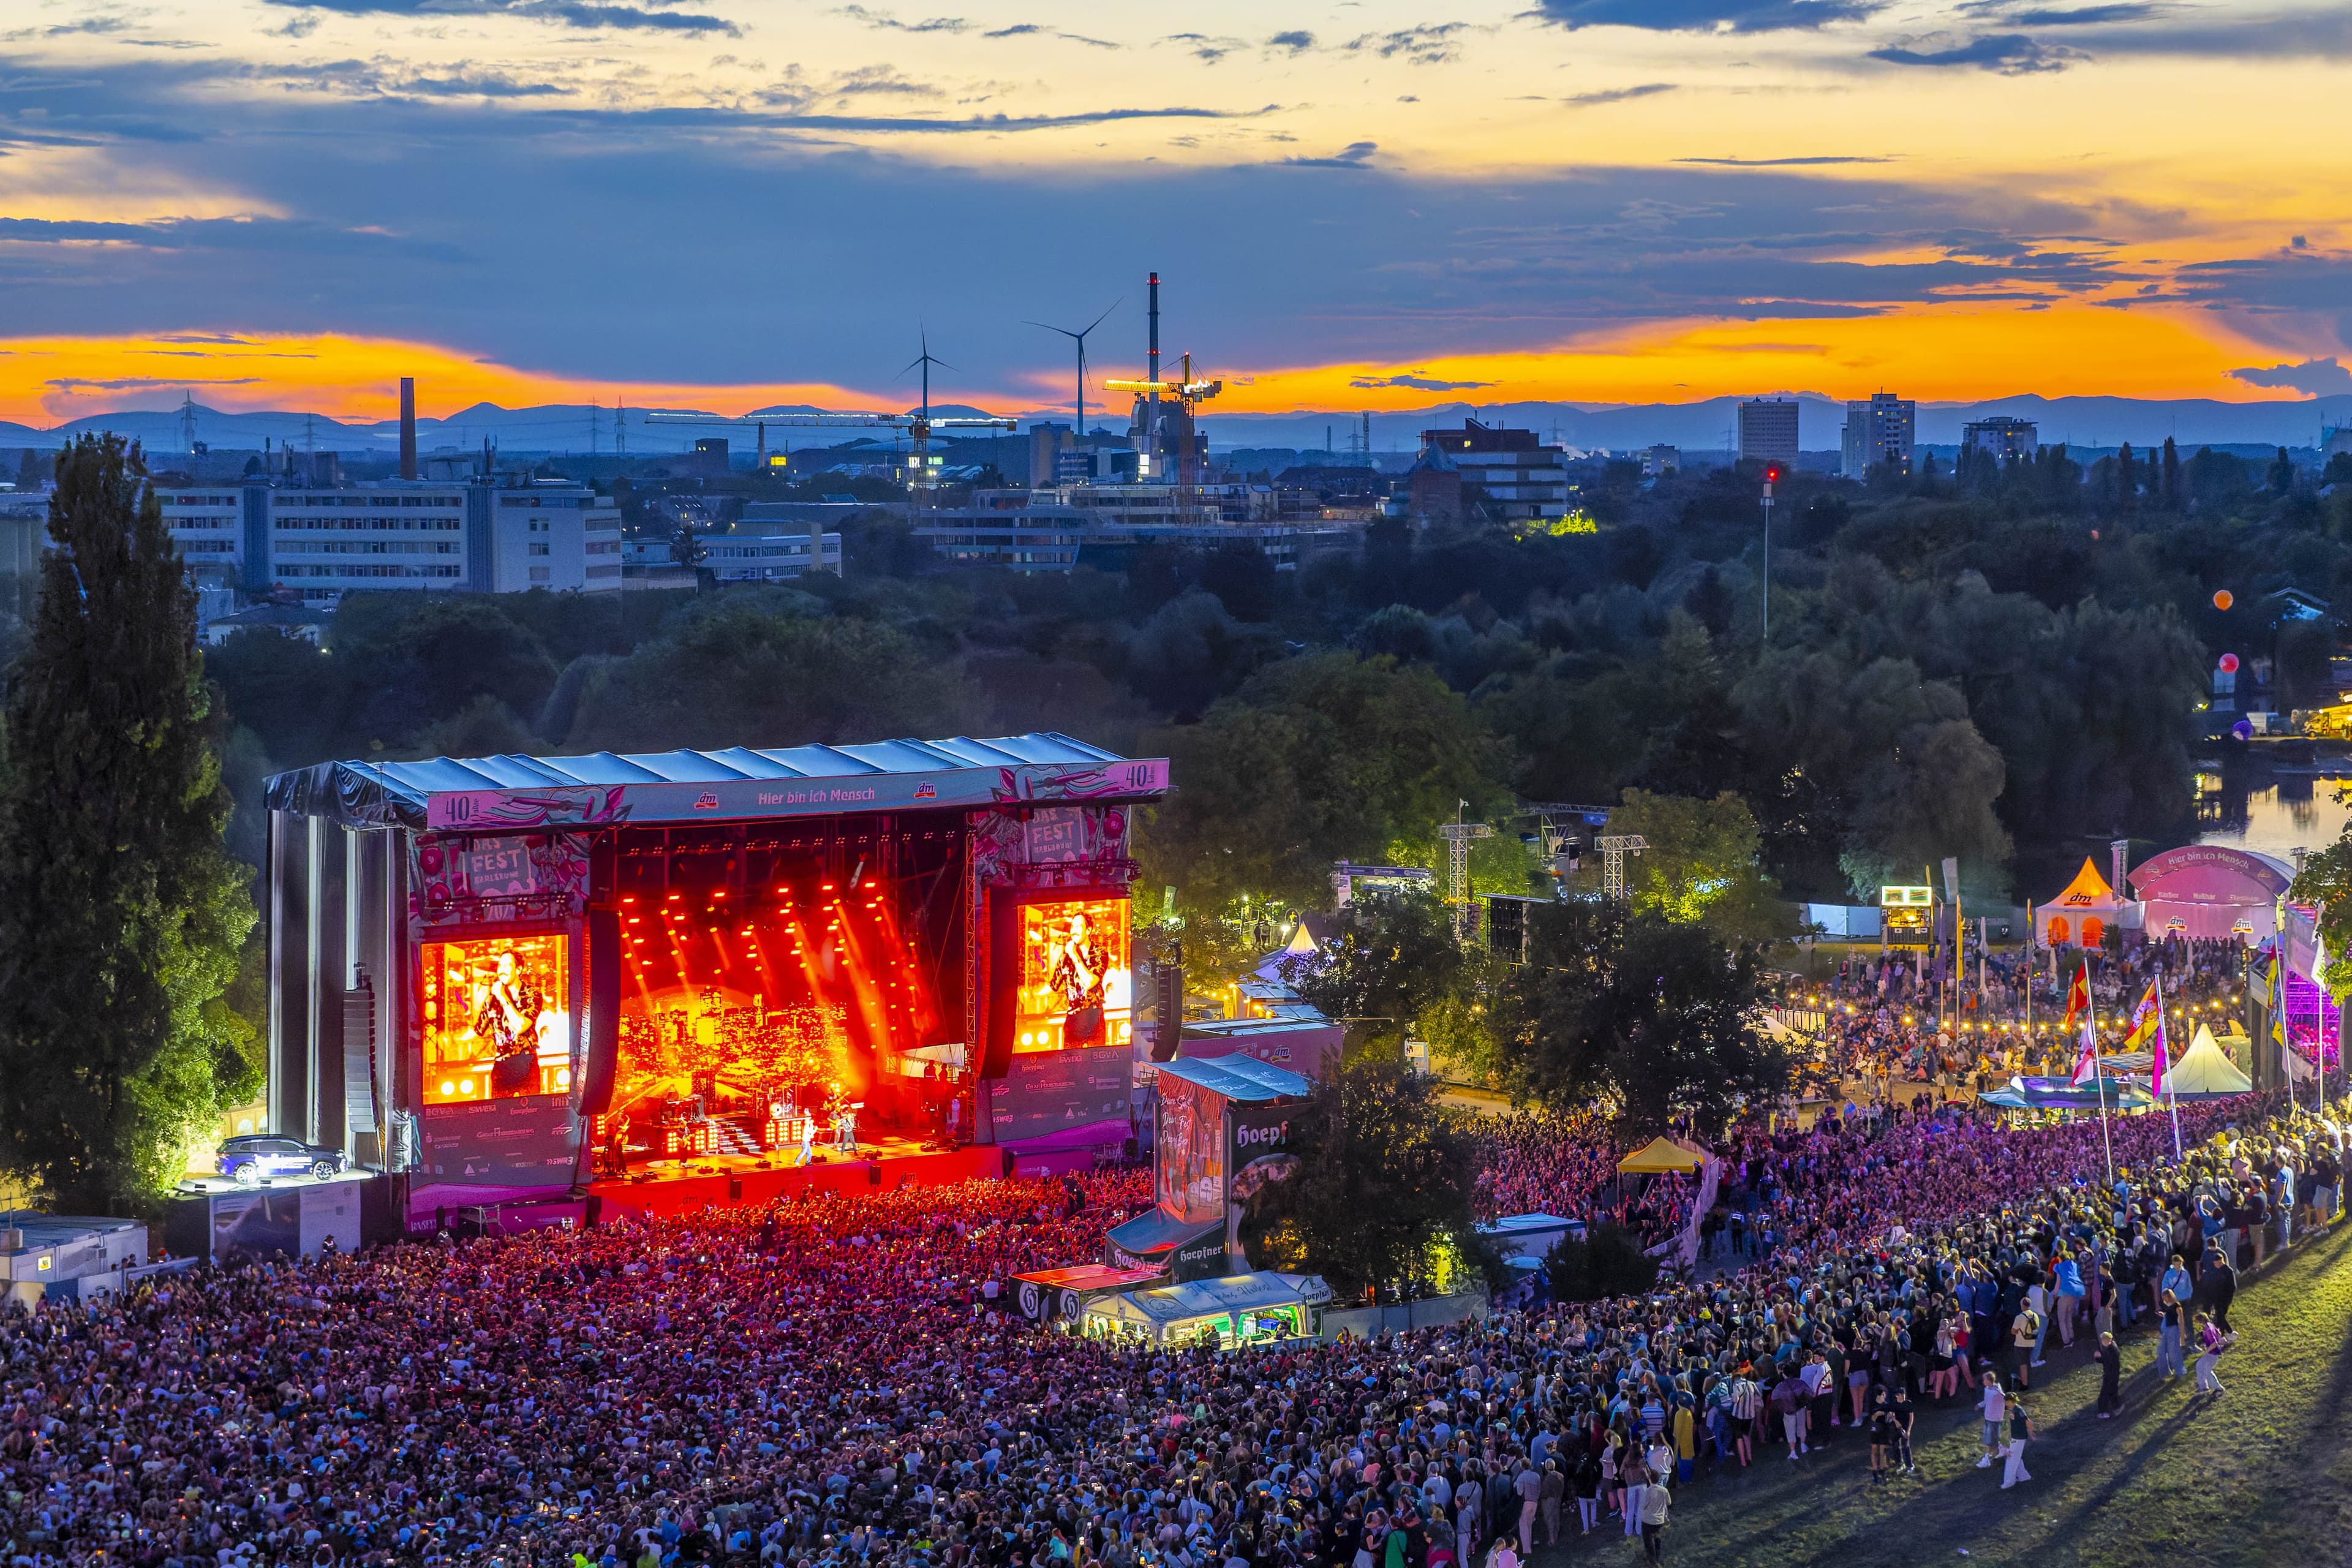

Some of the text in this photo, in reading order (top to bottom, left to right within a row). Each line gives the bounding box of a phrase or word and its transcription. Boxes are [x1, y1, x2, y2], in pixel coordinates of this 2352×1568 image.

[1126, 764, 1147, 788] 40
[919, 782, 934, 793] dm
[699, 792, 716, 804] dm
[758, 787, 875, 805] Hier bin ich Mensch
[446, 796, 470, 822] 40
[1033, 821, 1074, 843] FEST
[471, 848, 521, 872] FEST
[2070, 892, 2092, 902] dm
[2170, 916, 2184, 926] dm
[2236, 919, 2250, 929] dm
[1275, 1045, 1289, 1057] dm
